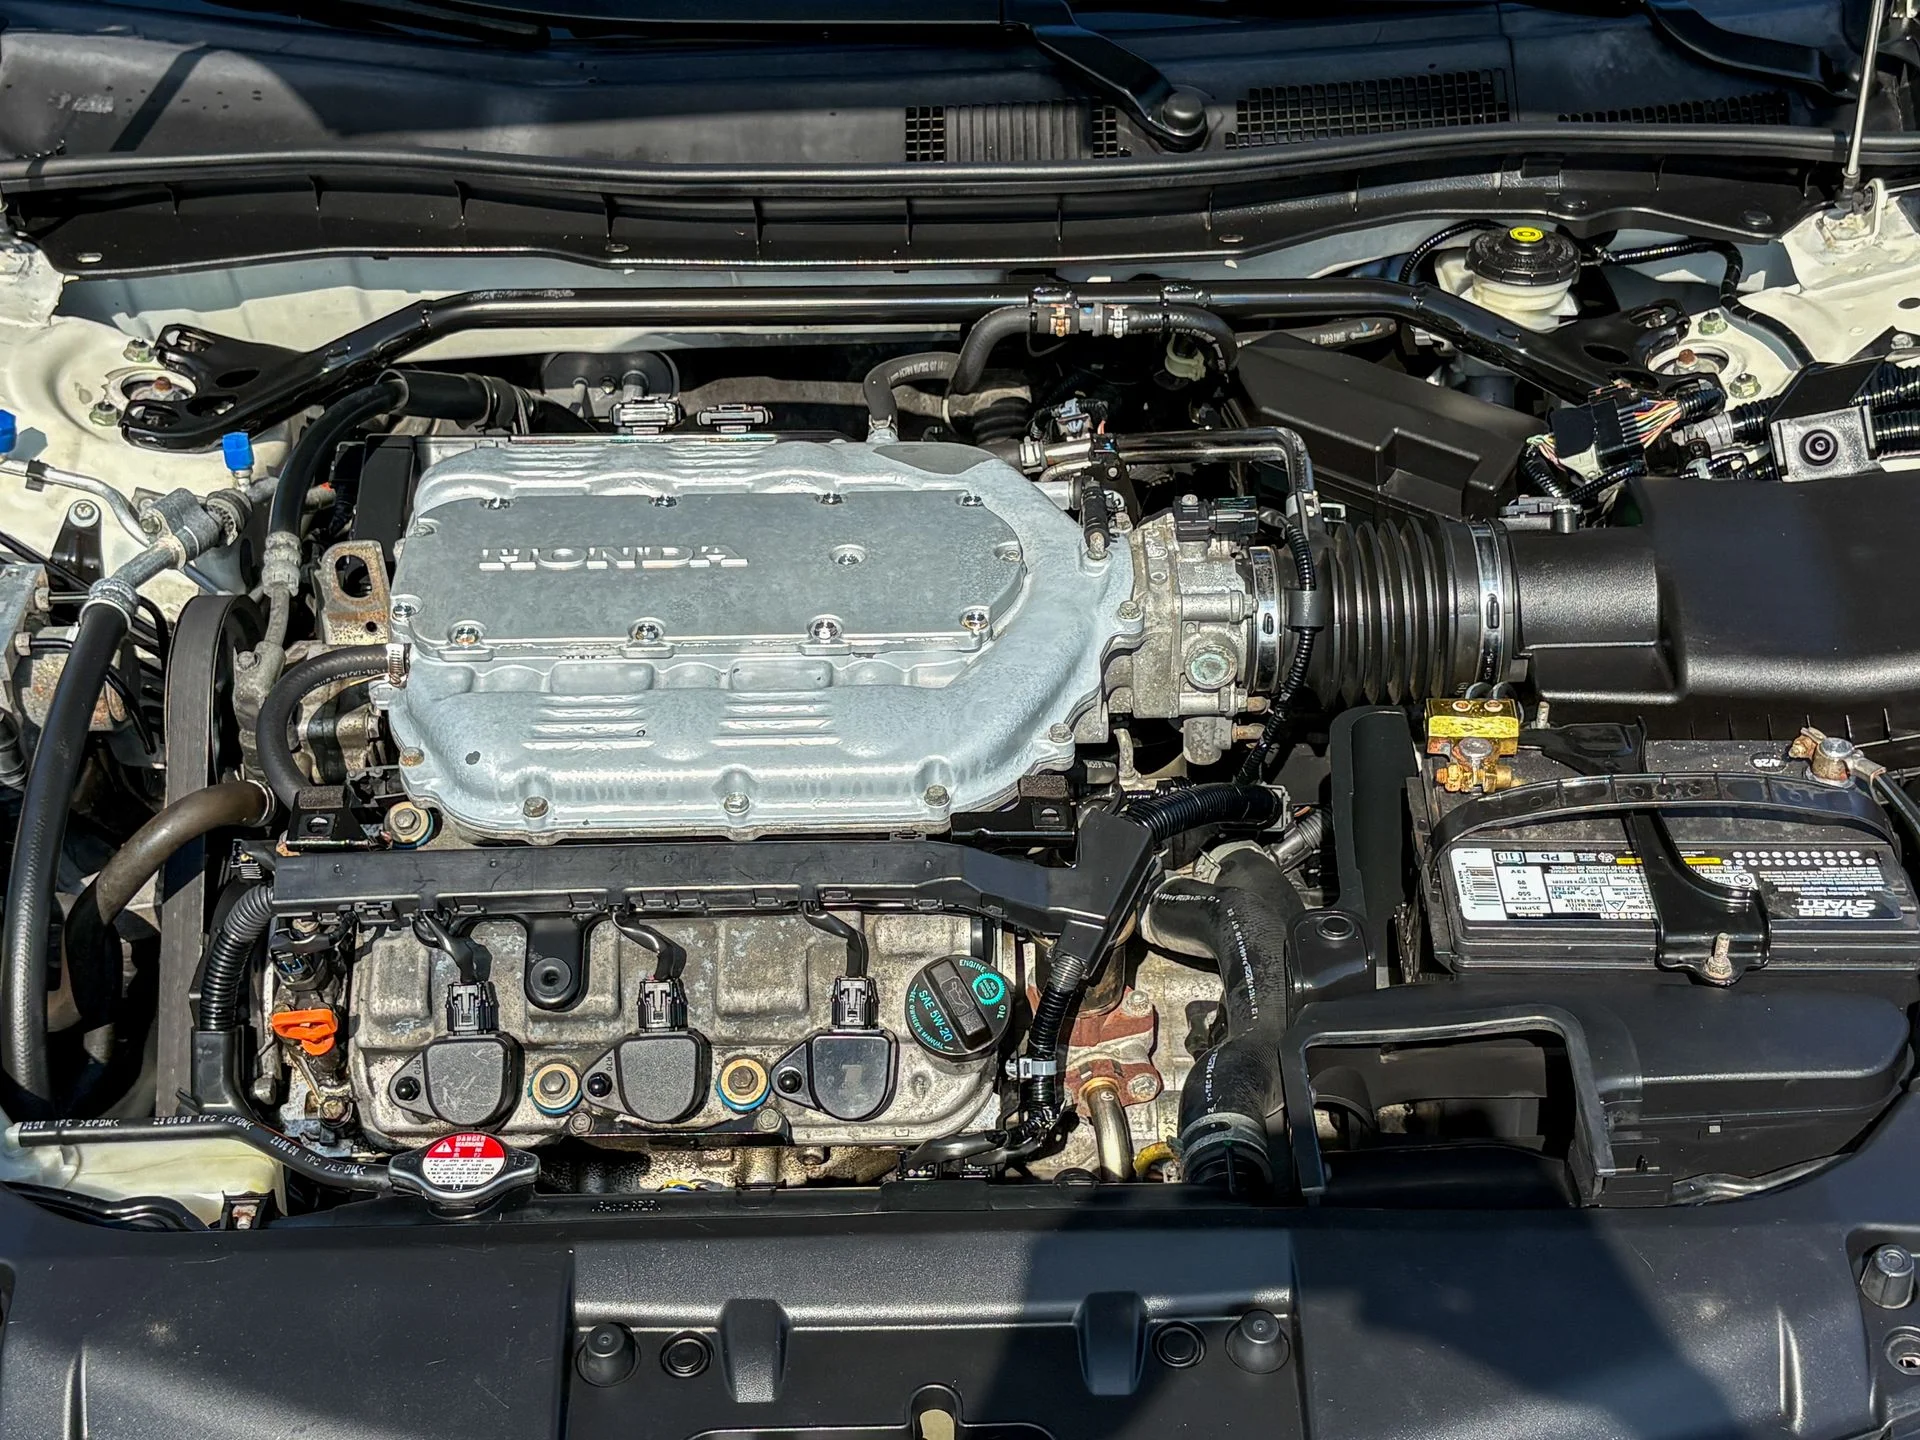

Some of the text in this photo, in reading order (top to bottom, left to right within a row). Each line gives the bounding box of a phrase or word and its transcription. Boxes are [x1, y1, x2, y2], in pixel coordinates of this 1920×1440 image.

[479, 545, 748, 571] HONDA
[1541, 853, 1560, 862] Pb
[1796, 898, 1877, 910] START
[1798, 908, 1870, 918] SUPER
[959, 959, 1006, 1019] ENGINE OIL
[919, 990, 953, 1042] SAE 5W-20
[921, 1031, 945, 1050] MANUAL
